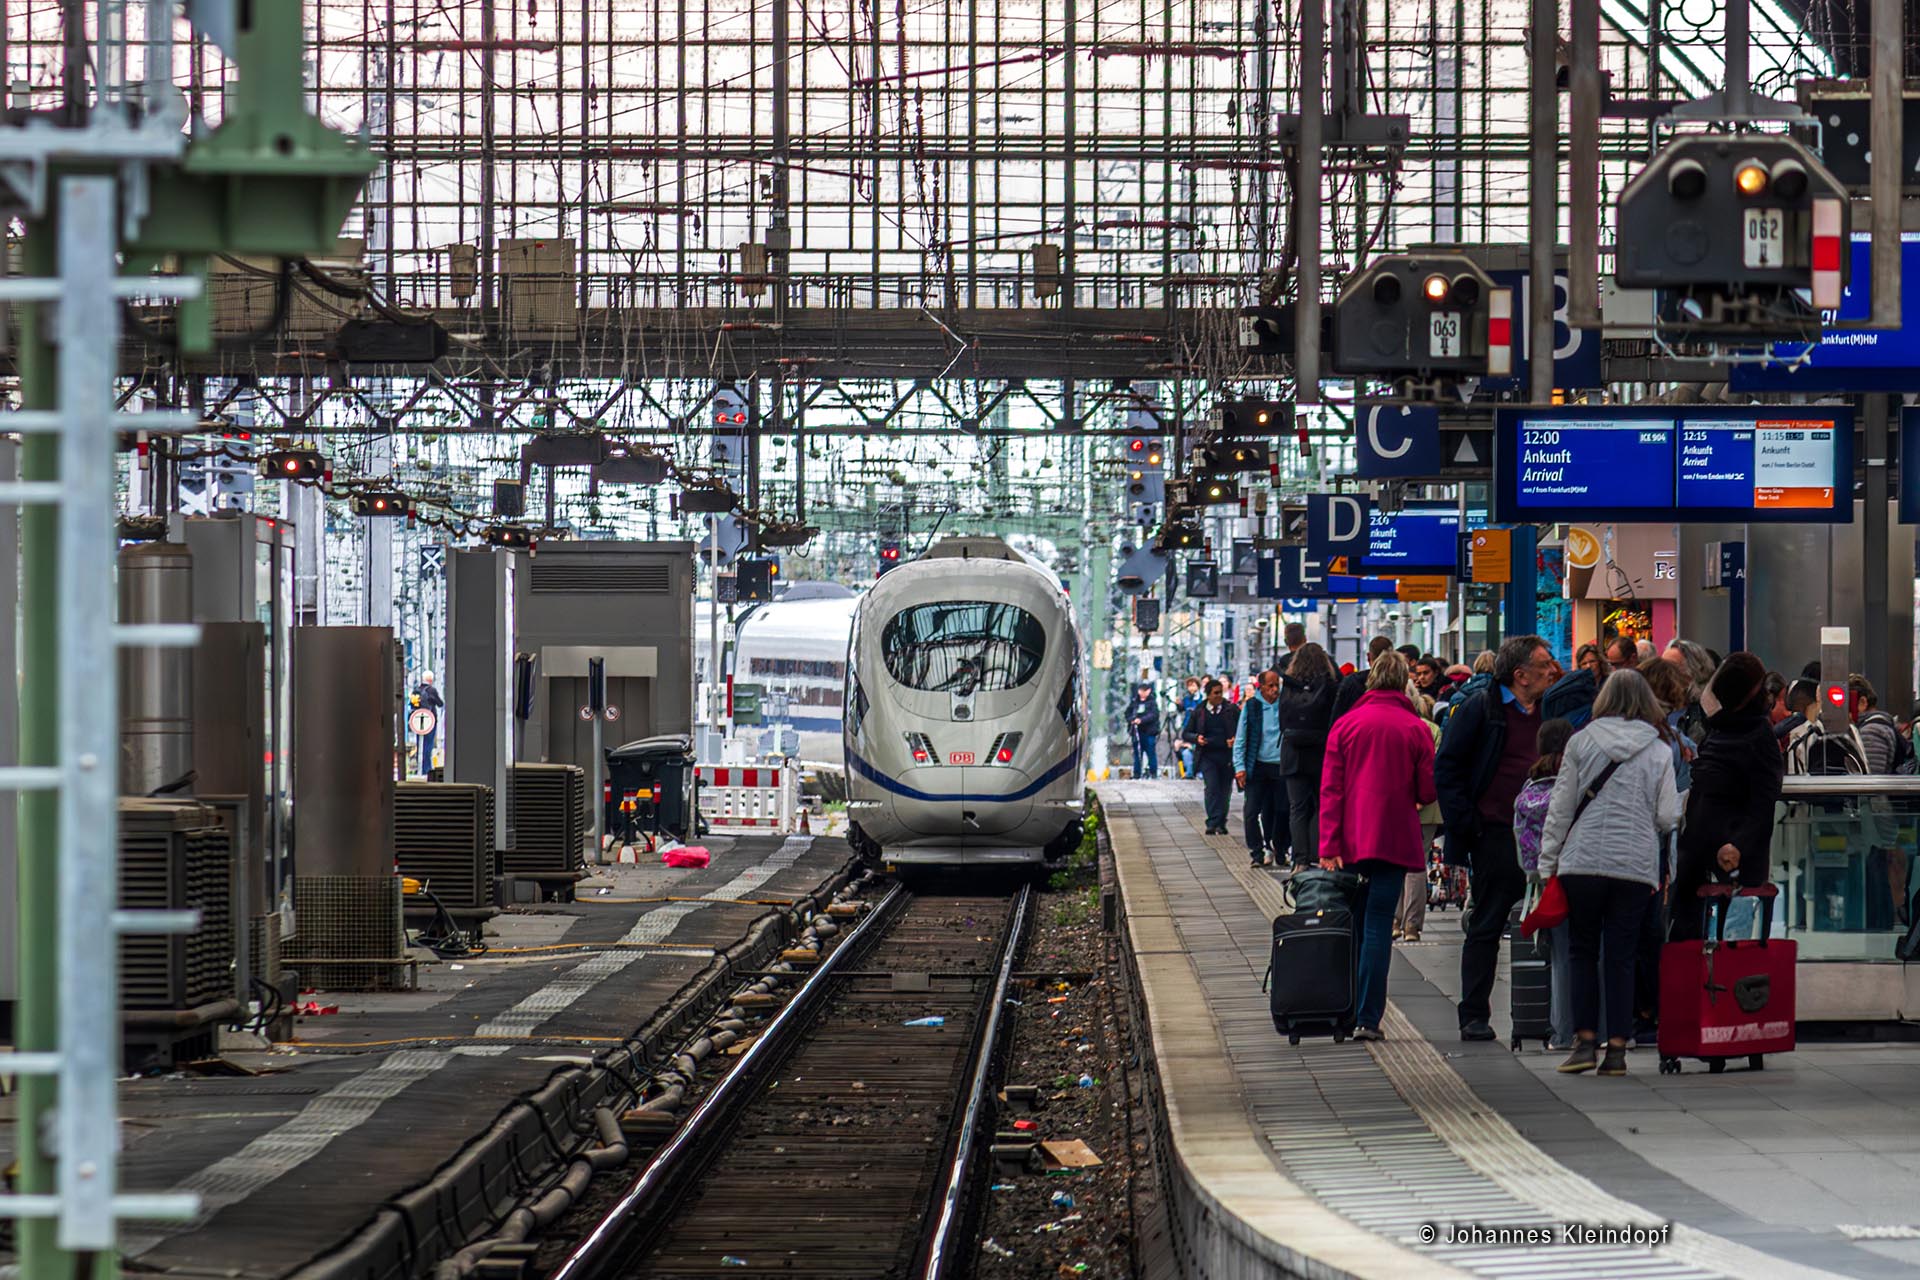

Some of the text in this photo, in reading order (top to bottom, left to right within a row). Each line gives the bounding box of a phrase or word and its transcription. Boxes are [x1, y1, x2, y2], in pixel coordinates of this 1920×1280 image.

[1750, 218, 1778, 240] 062
[1522, 275, 1582, 360] B
[1434, 320, 1456, 337] 063
[1440, 337, 1449, 349] II
[1368, 405, 1413, 458] C
[1683, 431, 1708, 441] 12:15
[1762, 431, 1785, 441] 11:15
[1524, 431, 1560, 445] 12:00
[1683, 445, 1713, 455] Ankunft
[1762, 446, 1790, 455] Ankunft
[1523, 449, 1572, 463] Ankunft
[1683, 457, 1708, 466] Arrival
[1523, 467, 1563, 481] Arrival
[1824, 489, 1831, 498] 7
[1328, 497, 1362, 541] D
[1370, 516, 1390, 526] 2:00
[1370, 528, 1397, 538] nkunft
[1370, 540, 1392, 549] rrival
[1300, 548, 1322, 582] E
[951, 753, 973, 763] DB
